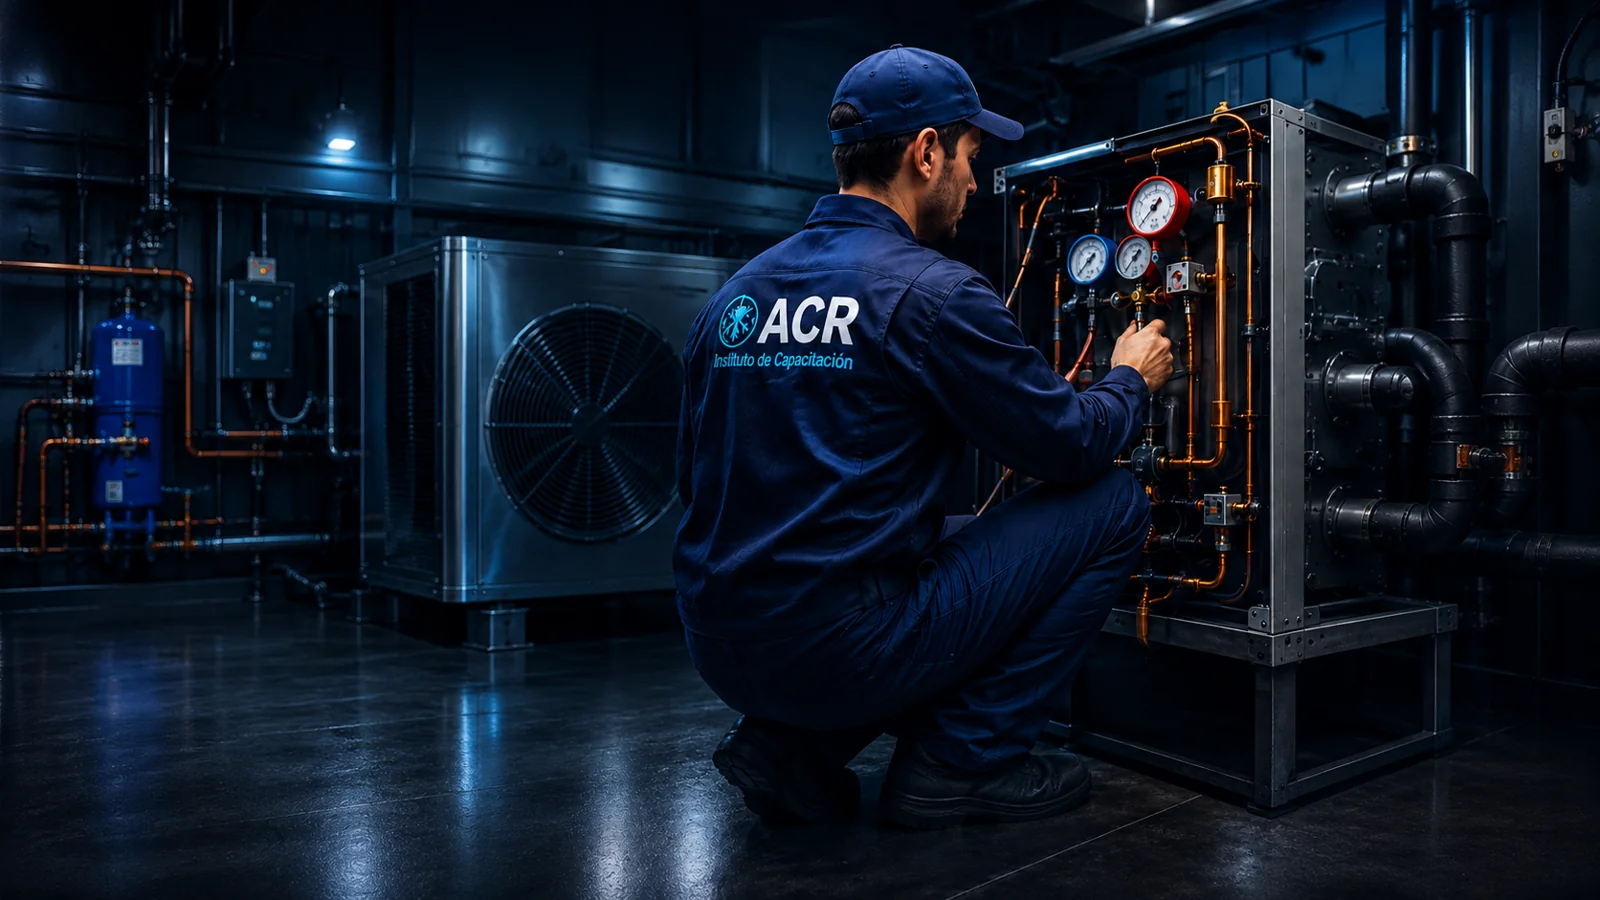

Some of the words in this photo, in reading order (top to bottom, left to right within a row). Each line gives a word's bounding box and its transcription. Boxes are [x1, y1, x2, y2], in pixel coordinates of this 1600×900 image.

[757, 295, 860, 346] ACR
[714, 352, 755, 368] Instituto
[757, 353, 771, 367] de
[774, 351, 853, 370] Capacitación
